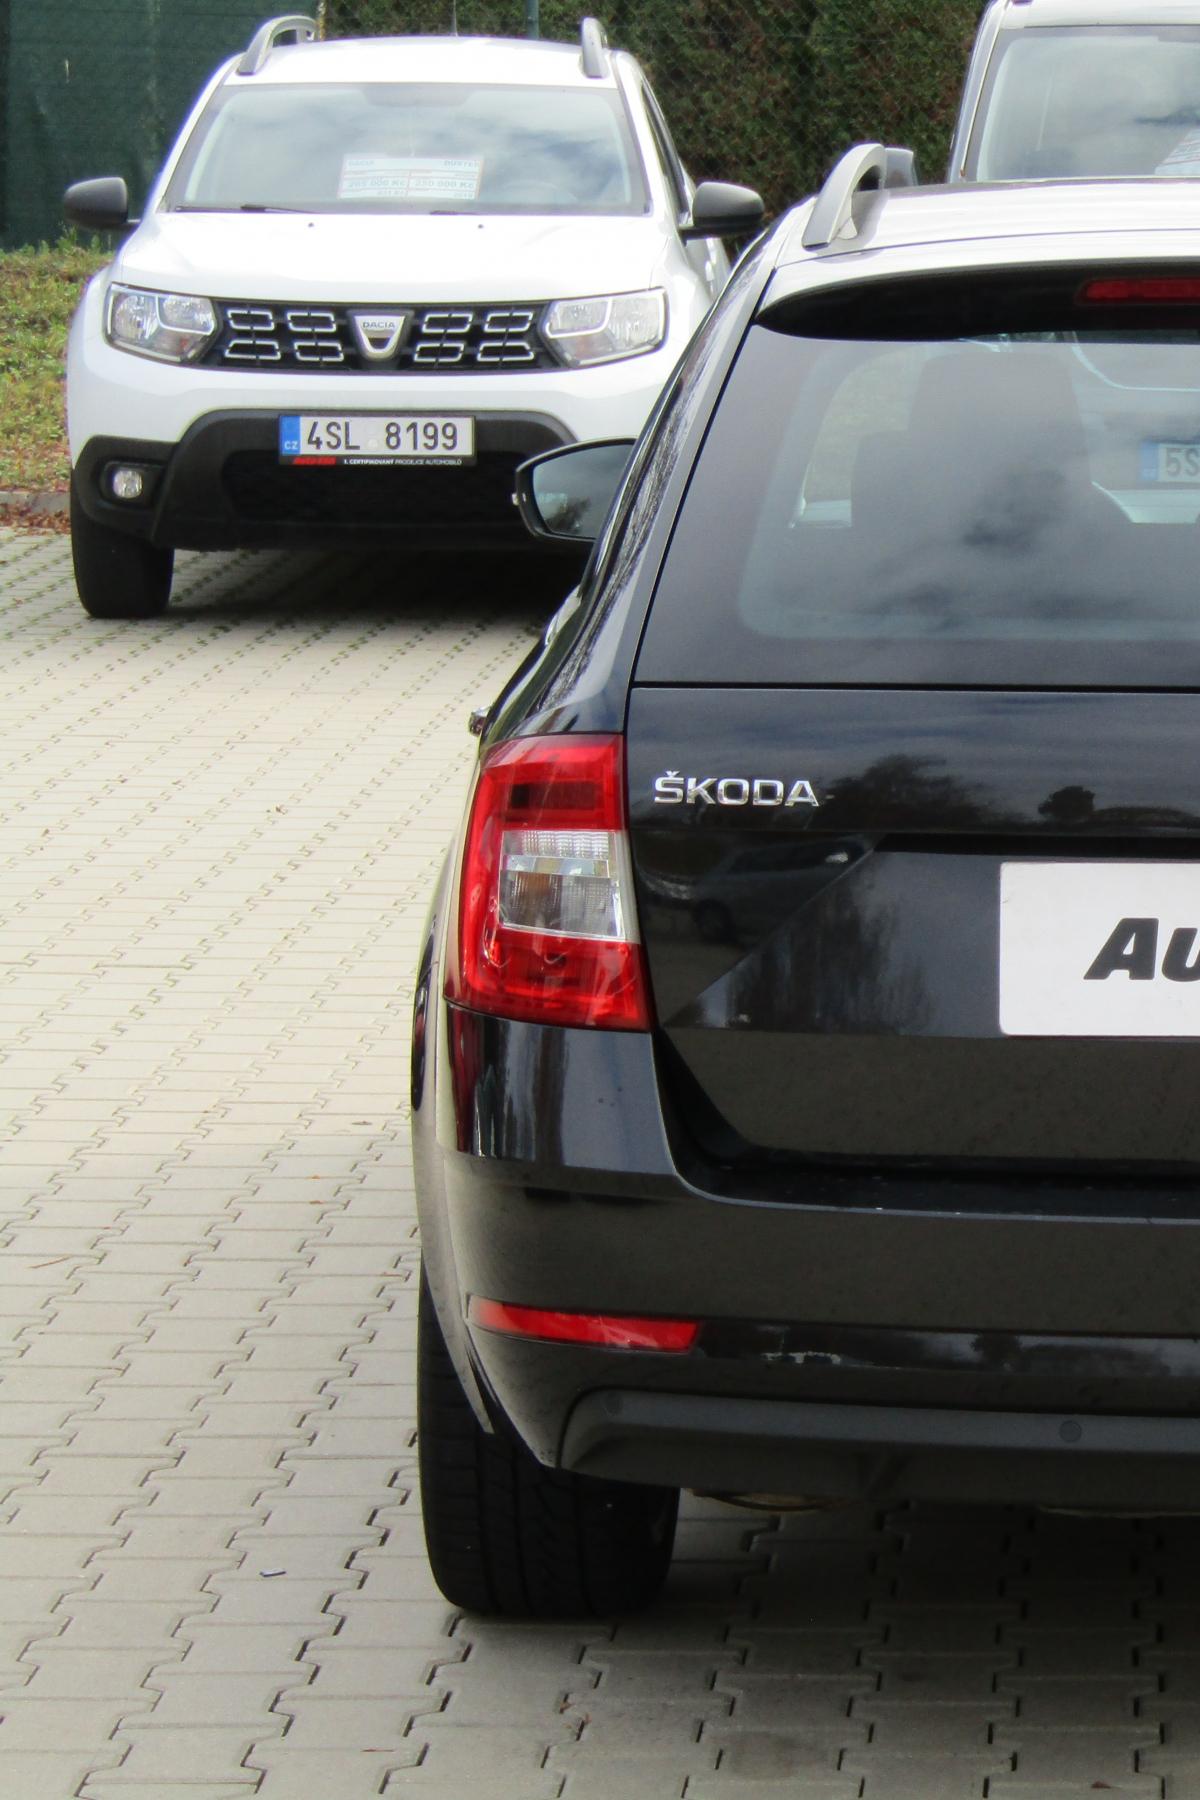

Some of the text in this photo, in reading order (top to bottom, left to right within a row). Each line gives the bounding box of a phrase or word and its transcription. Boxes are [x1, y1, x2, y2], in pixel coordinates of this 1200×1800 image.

[362, 321, 396, 329] DACIA
[284, 441, 298, 450] CZ
[307, 421, 458, 451] 4SL 8199
[653, 770, 820, 808] ŠKODA
